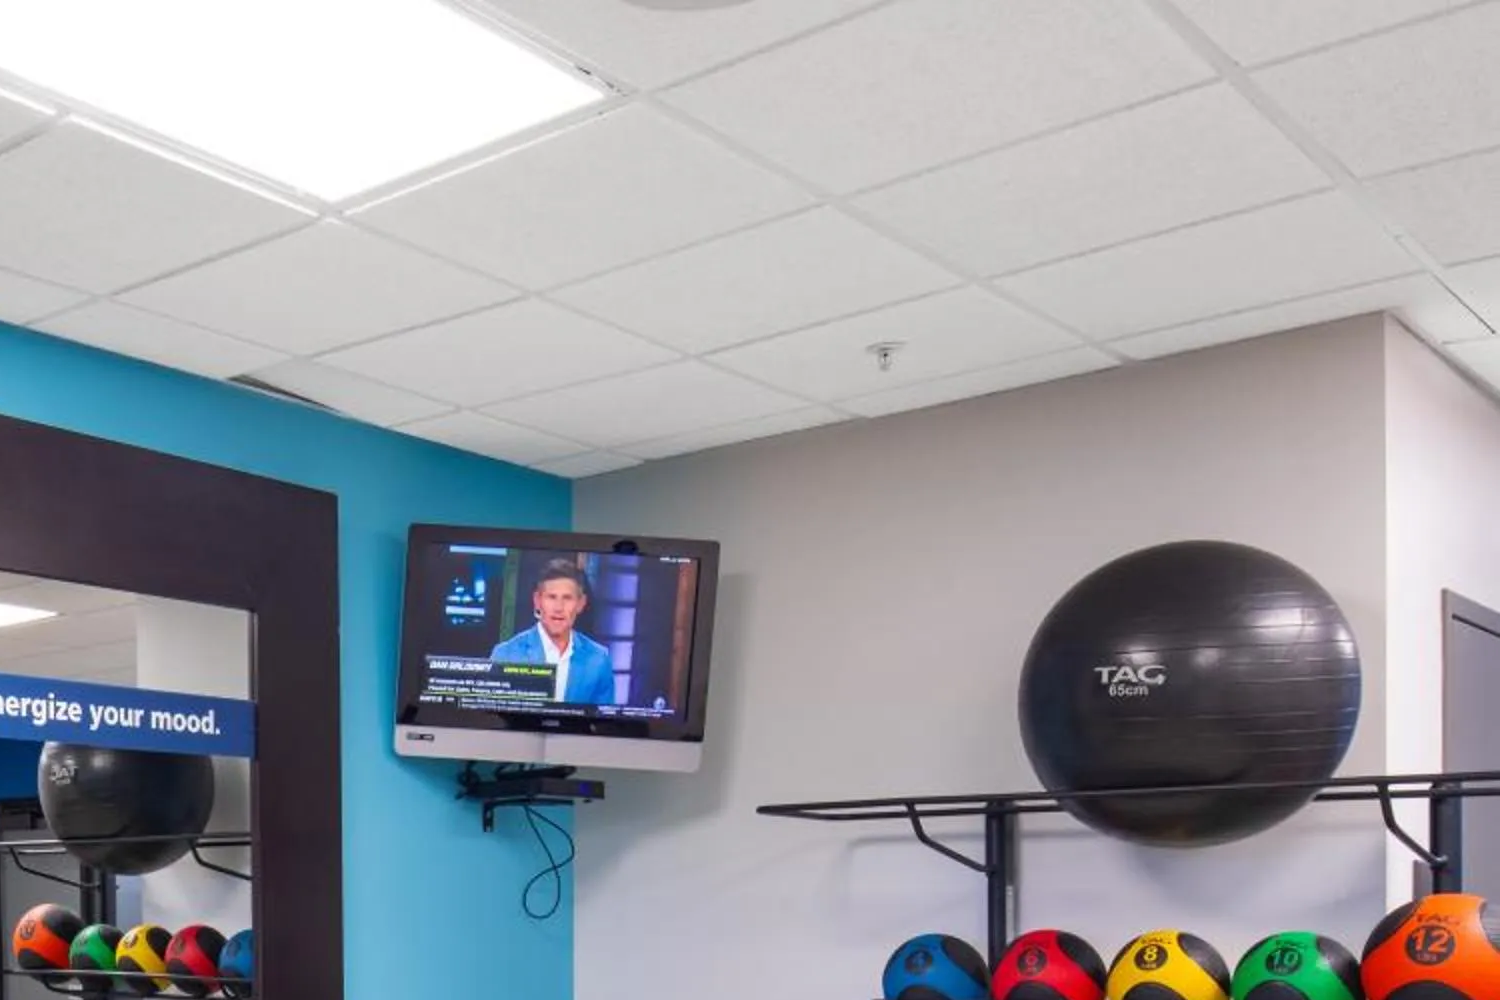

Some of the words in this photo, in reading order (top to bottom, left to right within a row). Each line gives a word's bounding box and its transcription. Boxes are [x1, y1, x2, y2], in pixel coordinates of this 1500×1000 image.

[1093, 664, 1168, 685] TAG
[1108, 684, 1149, 698] 65cm
[89, 702, 145, 731] your
[151, 708, 221, 735] mood.
[1412, 928, 1449, 953] 12
[1143, 945, 1159, 962] 8
[1271, 948, 1299, 965] 10
